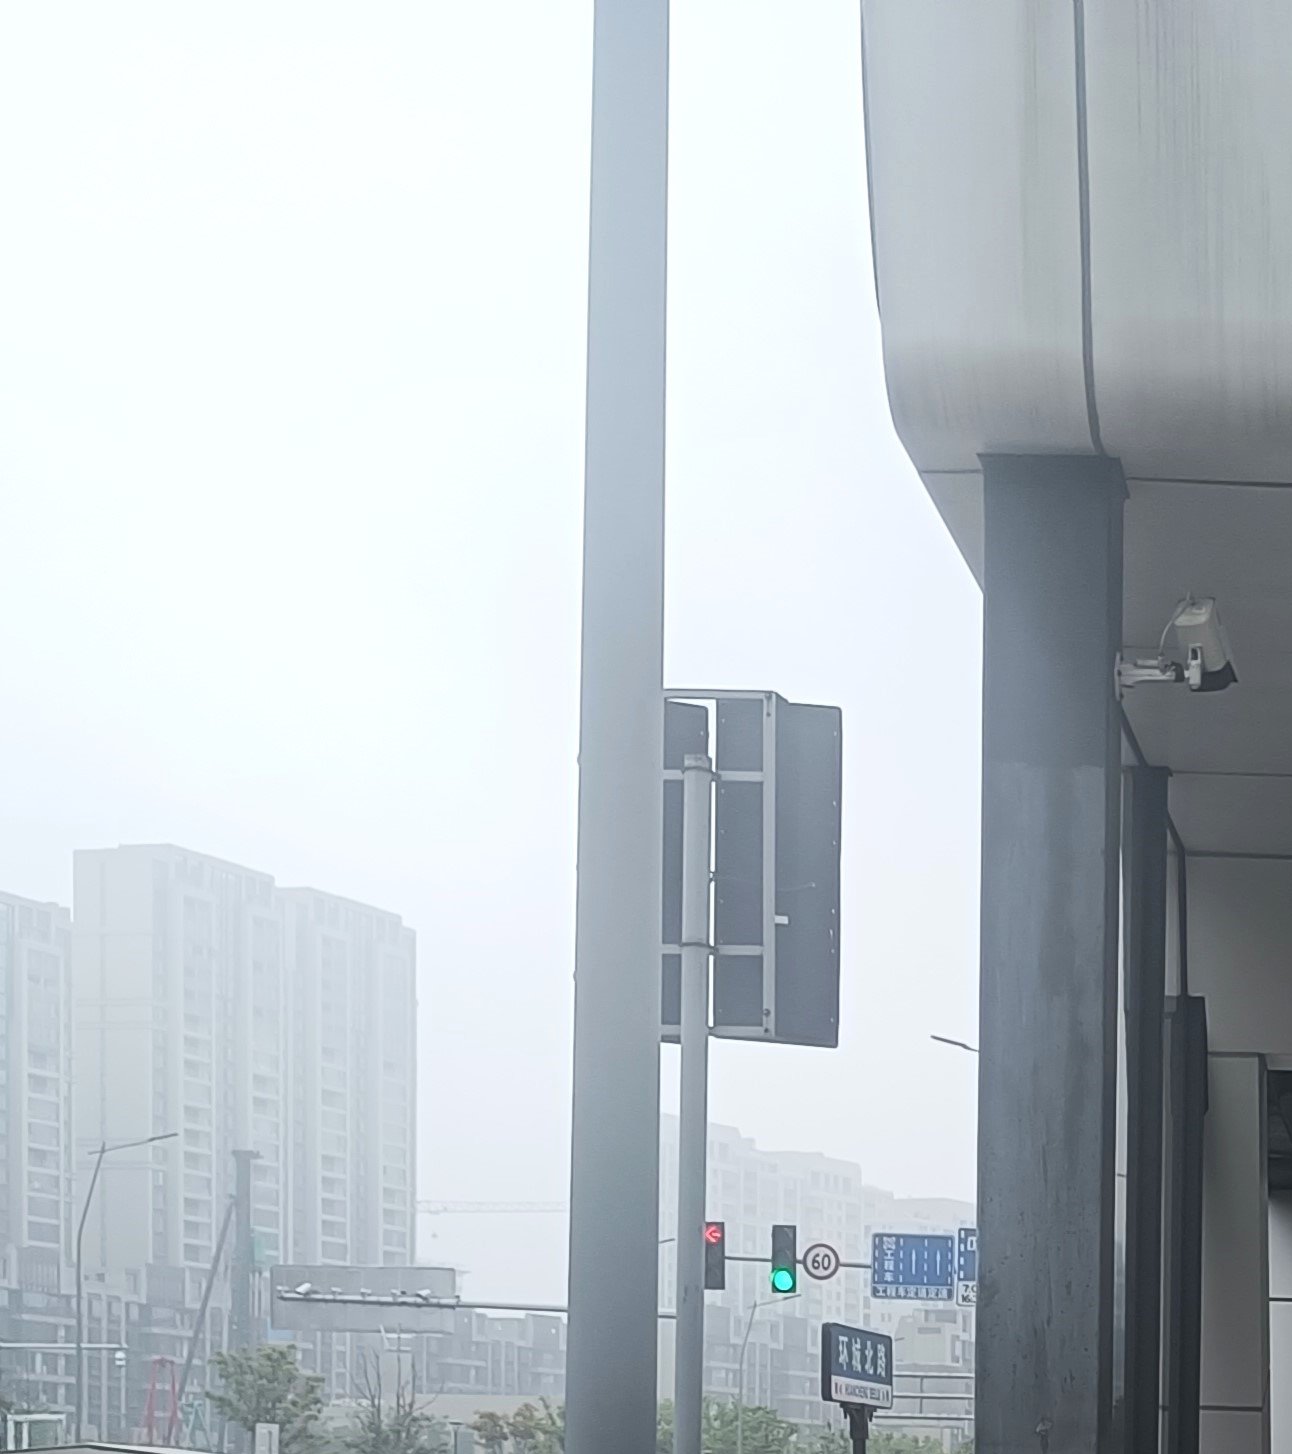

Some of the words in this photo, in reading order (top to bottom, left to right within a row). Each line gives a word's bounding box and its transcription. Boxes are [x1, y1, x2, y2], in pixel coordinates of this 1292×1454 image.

[811, 1253, 831, 1271] 60
[838, 1335, 886, 1378] 环城北路
